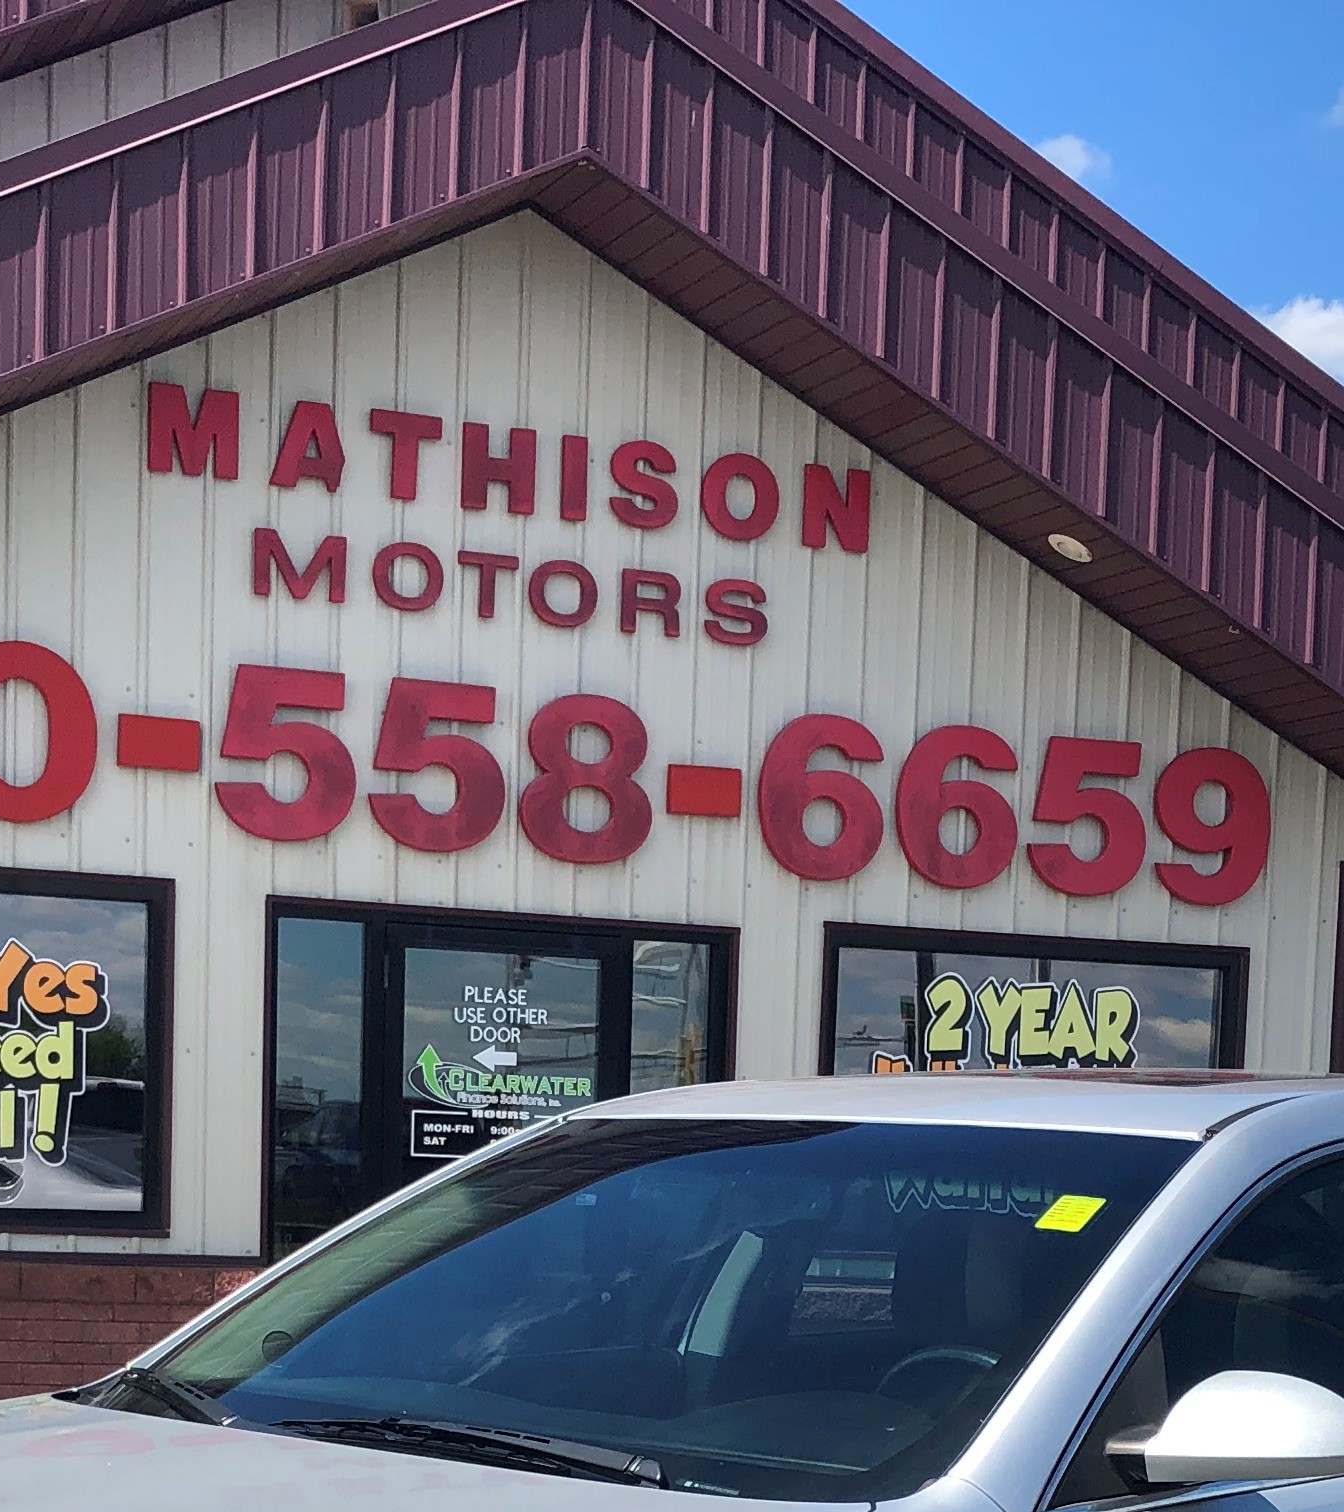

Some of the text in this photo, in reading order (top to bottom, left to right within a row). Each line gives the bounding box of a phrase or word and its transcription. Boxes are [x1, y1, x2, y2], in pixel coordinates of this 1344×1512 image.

[146, 380, 872, 554] MATHISON
[252, 526, 769, 646] MOTORS
[464, 985, 528, 1006] PLEASE
[453, 1007, 548, 1026] USE OTHER
[925, 976, 1137, 1065] 2 YEAR
[469, 1026, 521, 1044] DOOR
[447, 1068, 593, 1097] CLEARWATER
[456, 1091, 499, 1105] Finance
[471, 1109, 531, 1120] HOURS
[423, 1123, 475, 1135] MON-FRI
[423, 1136, 447, 1146] SAT
